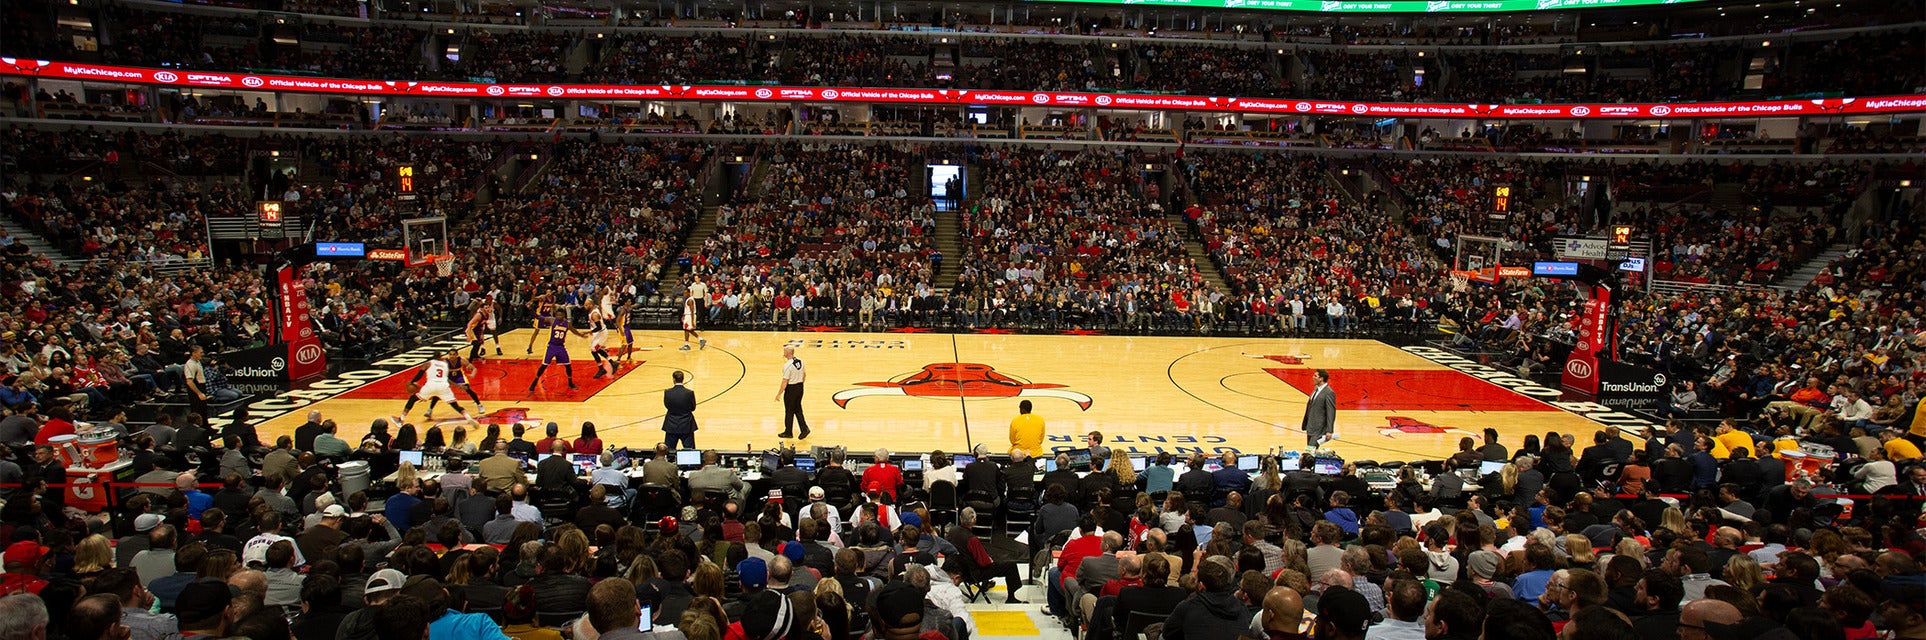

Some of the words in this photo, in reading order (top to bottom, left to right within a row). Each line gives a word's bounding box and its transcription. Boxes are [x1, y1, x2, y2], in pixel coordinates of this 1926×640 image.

[64, 66, 142, 78] MyKiaChicago.com
[342, 82, 366, 90] Chicago
[422, 86, 477, 94] MyKiaChicago.com
[696, 90, 747, 98] MyKiaChicago.com
[975, 94, 1025, 102] MyKiaChicago.com
[1240, 102, 1287, 110] MyKiaChicago.com
[1504, 108, 1560, 116] MyKiaChicago.com
[402, 178, 412, 191] 14
[1497, 198, 1506, 211] 14
[284, 296, 292, 314] NBA
[286, 315, 292, 328] TV
[554, 331, 564, 339] 30
[1596, 332, 1602, 344] TV
[299, 348, 317, 362] KIA
[436, 369, 443, 378] 3
[1400, 345, 1563, 396] CHICAGO
[1571, 362, 1587, 376] KIA
[1601, 382, 1657, 392] TransUnion
[1050, 446, 1231, 454] UNITD
[1603, 464, 1619, 476] G
[72, 478, 94, 499] G
